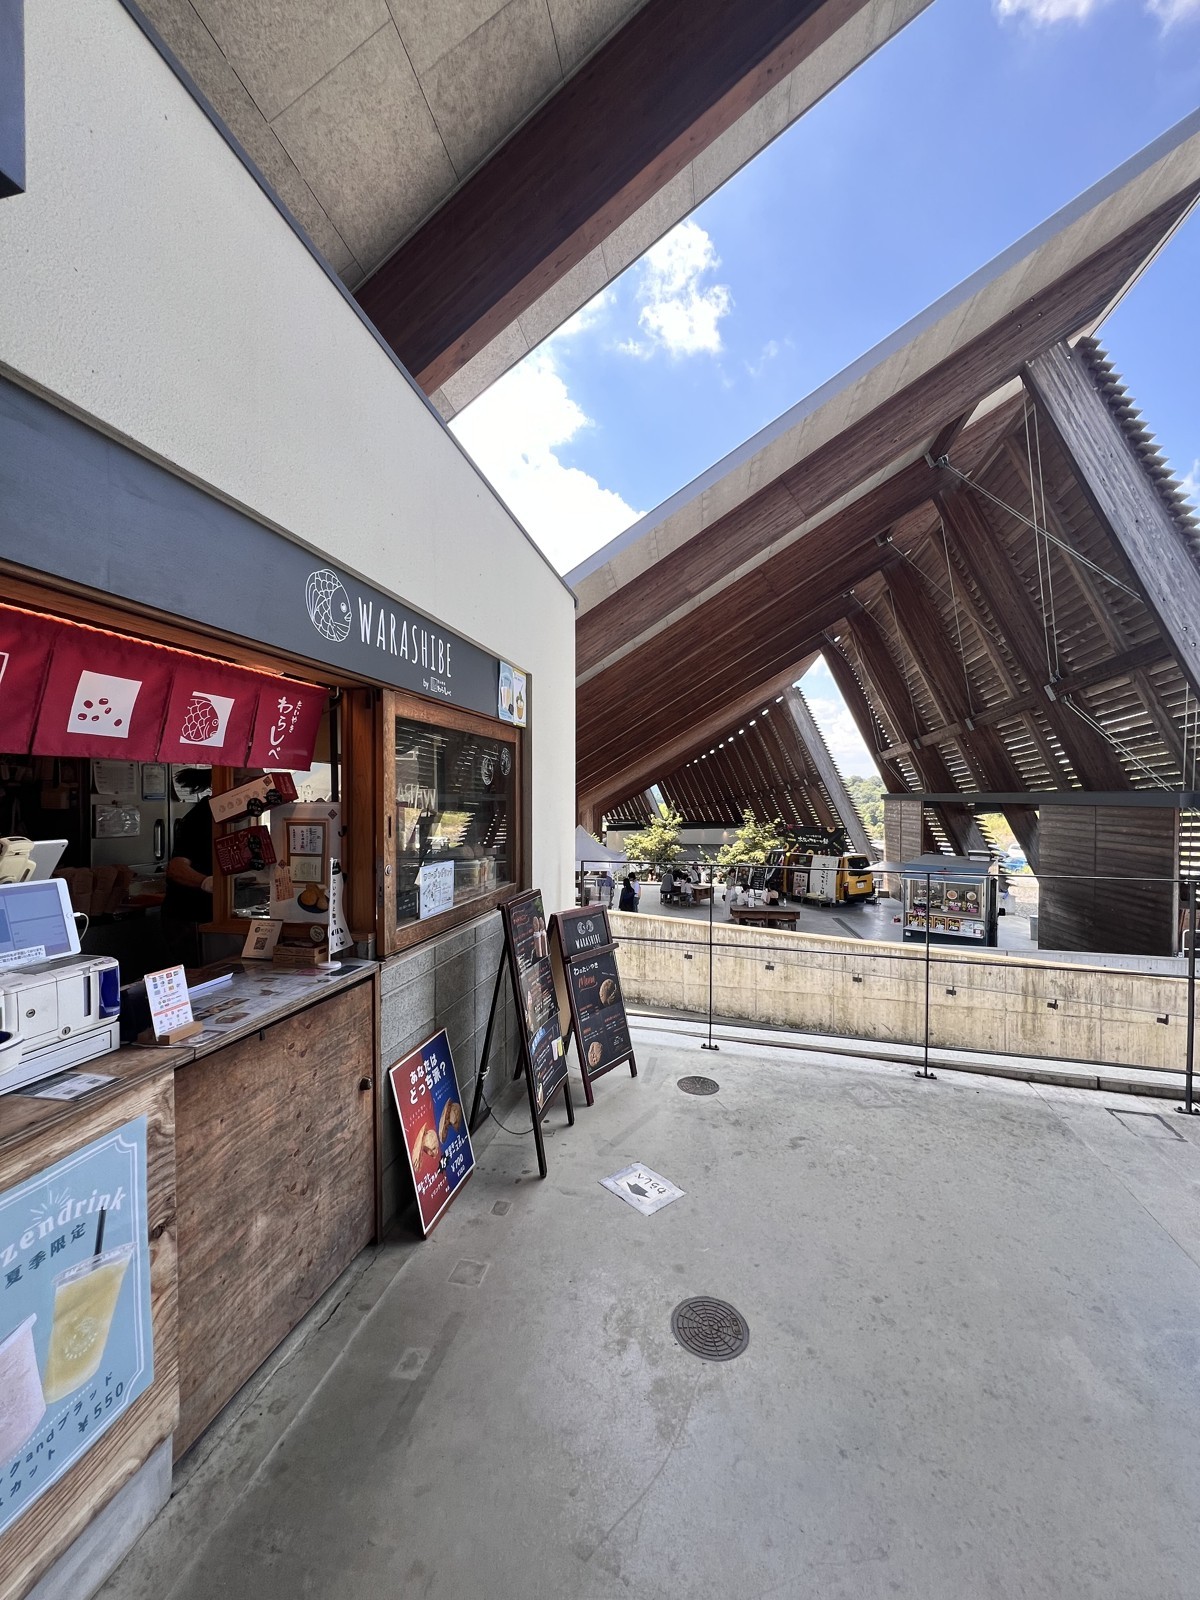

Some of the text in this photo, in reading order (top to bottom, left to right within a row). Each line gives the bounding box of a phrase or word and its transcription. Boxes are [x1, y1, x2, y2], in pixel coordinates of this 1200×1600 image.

[358, 597, 452, 678] WARASHIBE
[268, 696, 294, 760] わらしべ
[288, 700, 303, 734] たいやき
[575, 933, 601, 949] WARASHIBE
[410, 1053, 438, 1085] あなたは
[4, 1222, 86, 1290] 夏季限定
[77, 1381, 124, 1433] ¥550
